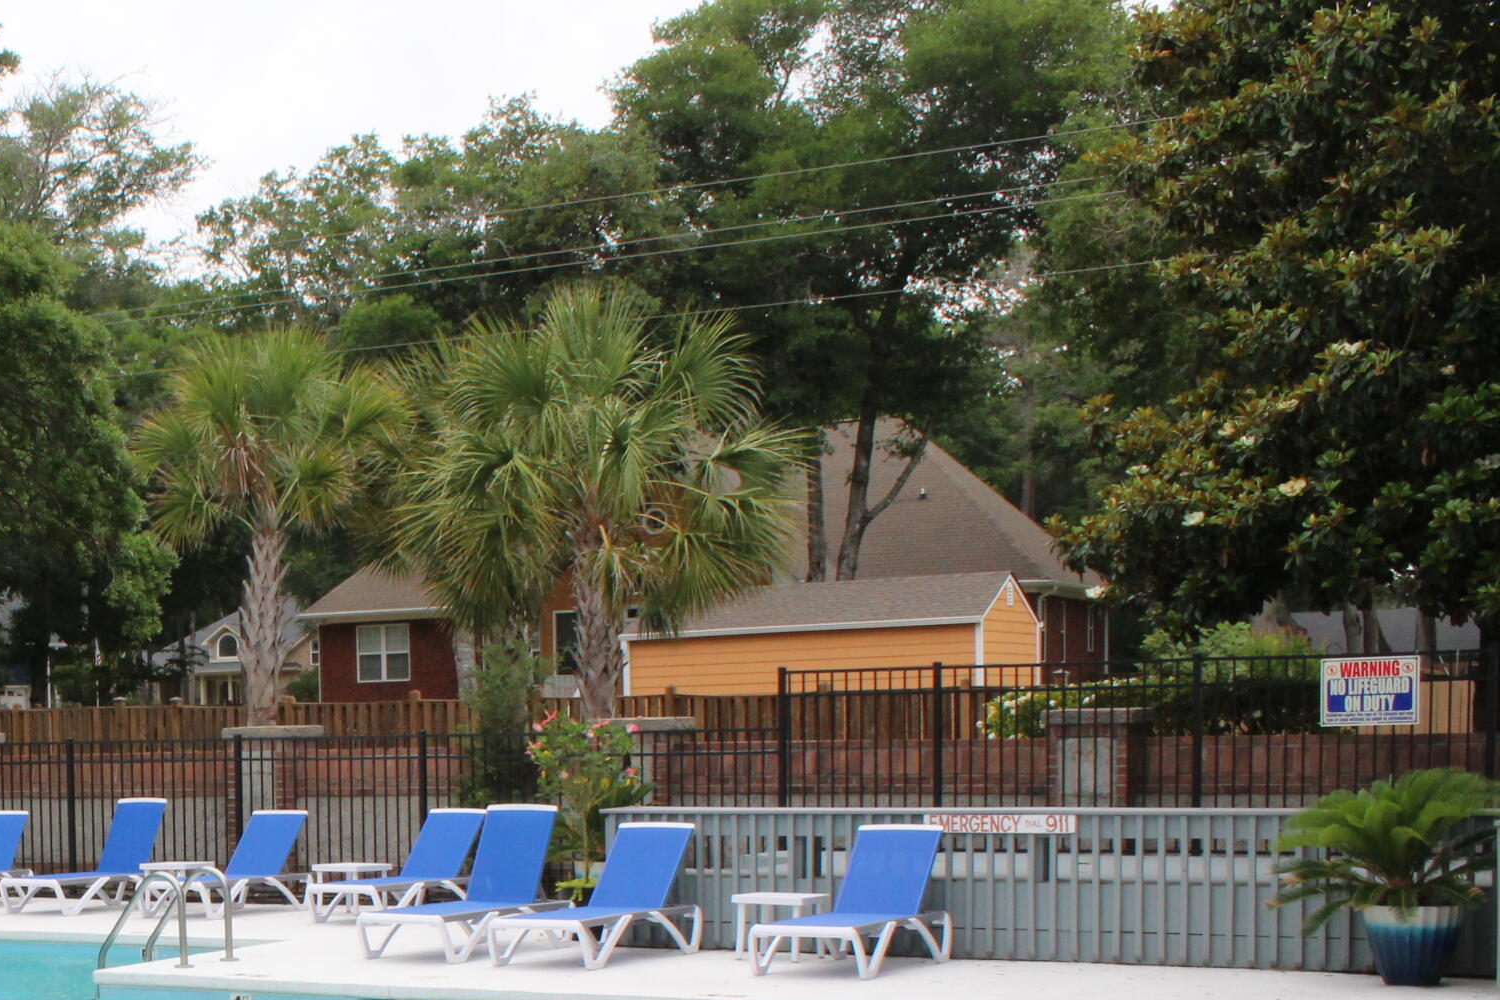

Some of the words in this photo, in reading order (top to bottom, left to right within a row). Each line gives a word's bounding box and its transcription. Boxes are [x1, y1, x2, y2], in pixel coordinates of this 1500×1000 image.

[1340, 660, 1400, 678] WARNING
[1330, 679, 1346, 696] NO
[1348, 677, 1410, 695] LIFEGUARD
[1344, 695, 1361, 712] ON
[1363, 694, 1395, 712] DUTY
[929, 814, 1021, 832] EMERGENCY
[1045, 815, 1069, 832] 911
